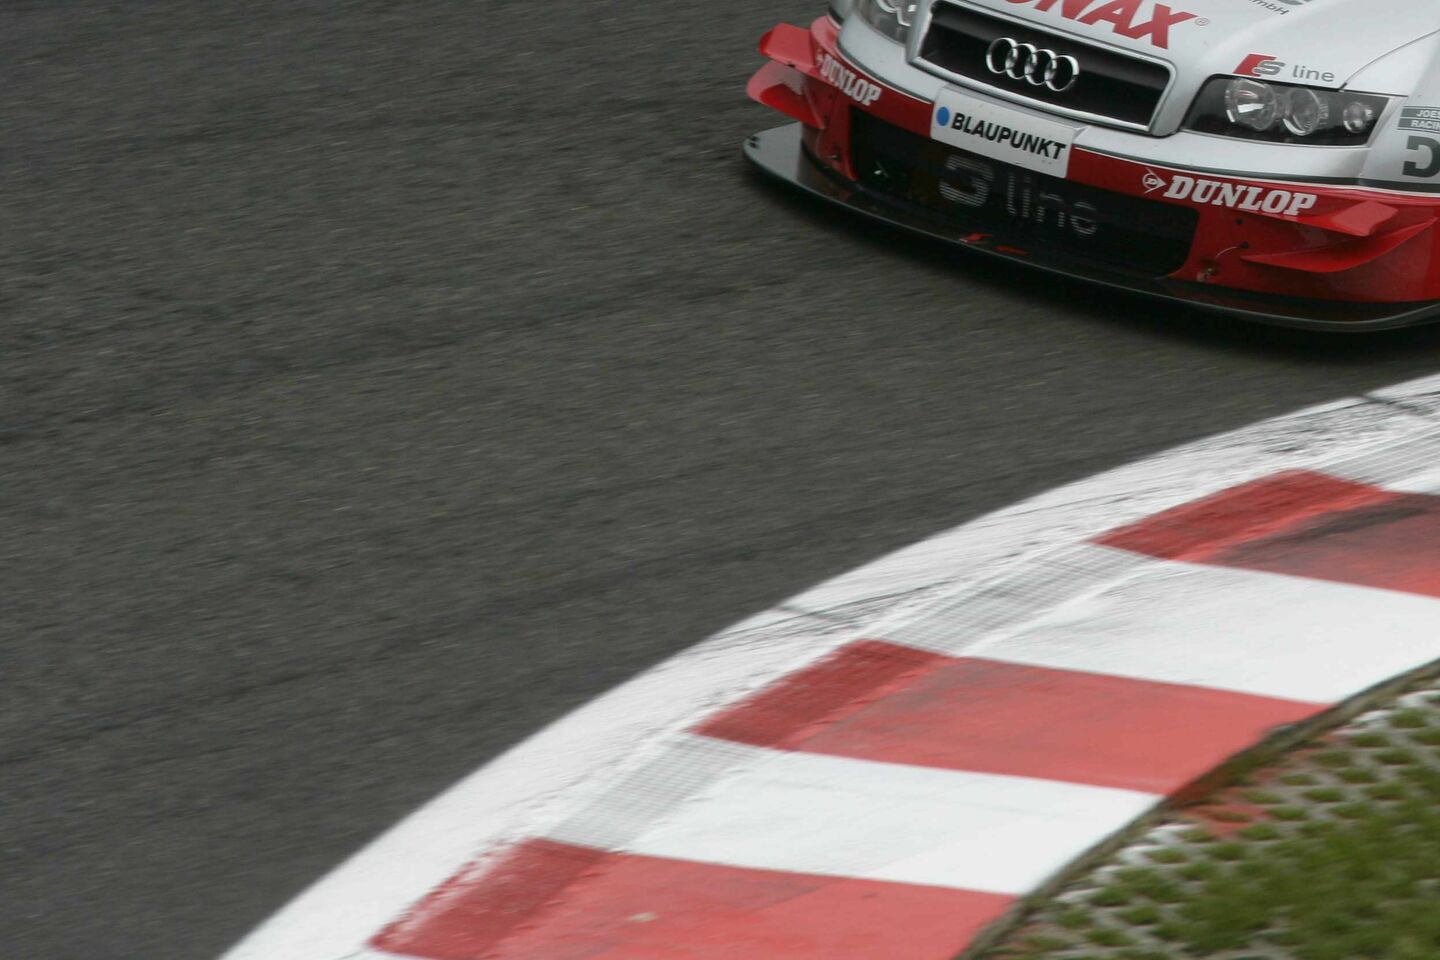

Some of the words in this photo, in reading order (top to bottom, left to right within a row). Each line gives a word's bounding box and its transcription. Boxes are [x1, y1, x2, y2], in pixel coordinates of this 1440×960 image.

[820, 56, 883, 107] DUNLOP
[1253, 59, 1287, 77] S
[1291, 64, 1336, 83] line
[951, 112, 1066, 160] BLAUPUNKT
[1163, 174, 1317, 217] DUNLOP
